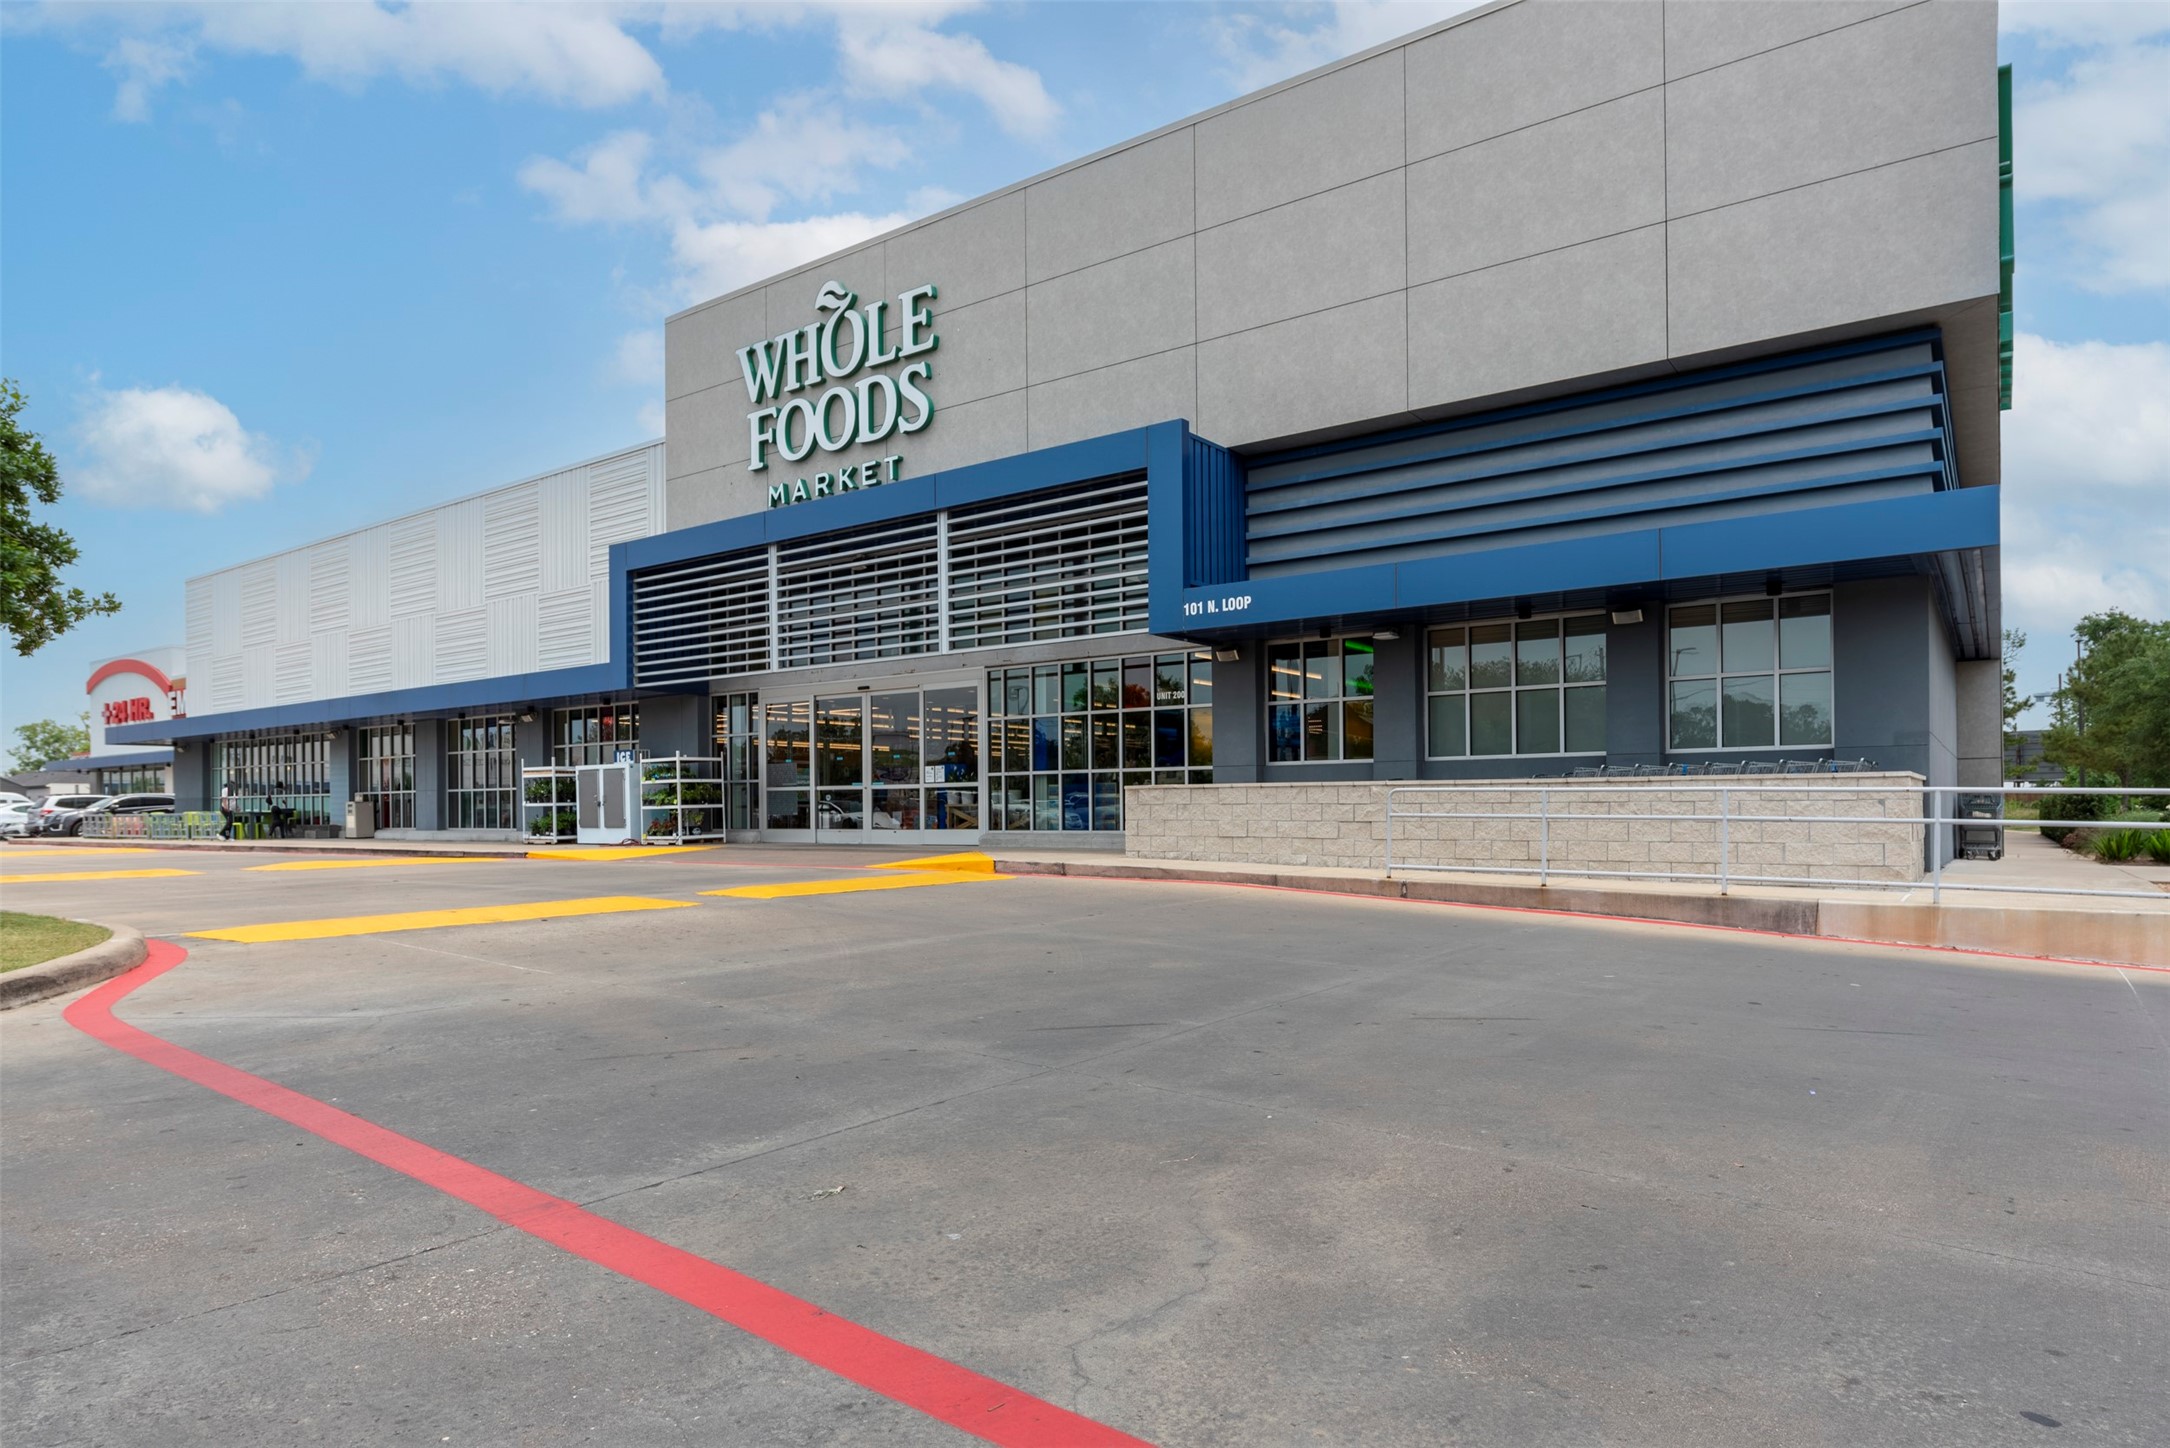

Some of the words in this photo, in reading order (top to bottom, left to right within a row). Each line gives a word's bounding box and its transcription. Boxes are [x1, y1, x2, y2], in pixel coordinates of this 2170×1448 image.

[736, 280, 940, 404] WHOLE
[746, 361, 935, 471] FOODS
[768, 455, 904, 508] MARKET
[1184, 601, 1203, 616] 101
[1207, 599, 1219, 613] N.
[1222, 595, 1252, 612] LOOP
[1156, 691, 1171, 700] UNIT
[1173, 690, 1185, 699] 200
[616, 751, 631, 763] ICE
